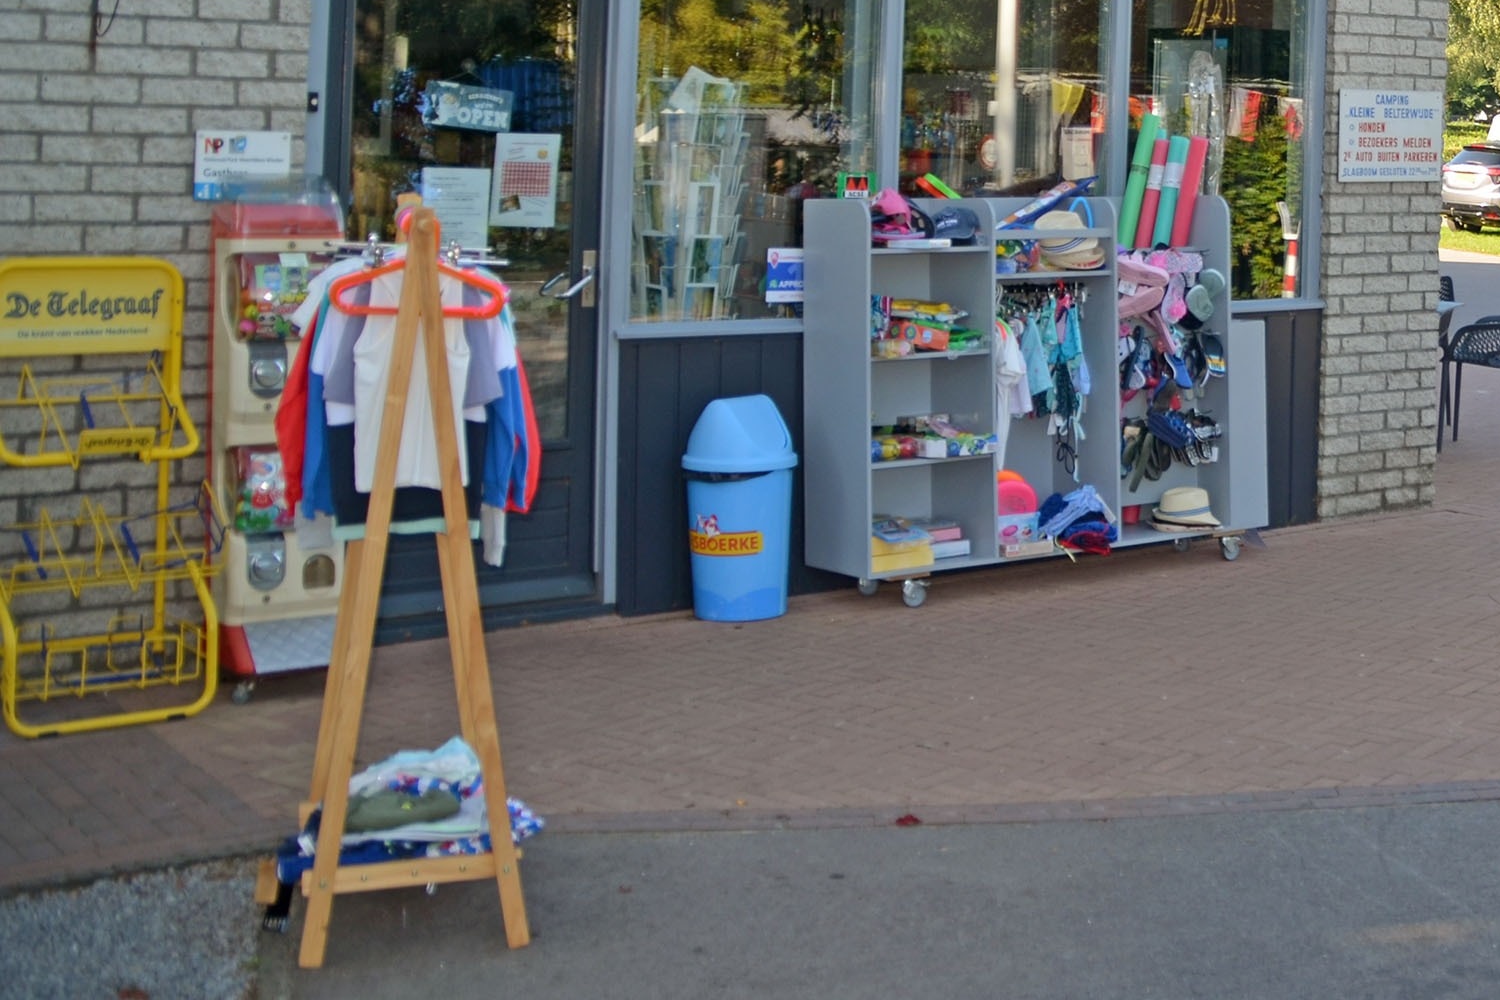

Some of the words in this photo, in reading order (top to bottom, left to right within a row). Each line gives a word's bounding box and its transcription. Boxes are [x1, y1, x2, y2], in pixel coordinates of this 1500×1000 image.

[1375, 94, 1409, 105] CAMPING
[457, 107, 509, 129] OPEN
[1358, 122, 1386, 133] HONDEN
[1358, 136, 1398, 148] BEZOEKERS
[1403, 137, 1432, 148] MELDEN
[1356, 151, 1373, 162] AUTO
[1377, 151, 1400, 162] BUITEN
[1403, 151, 1438, 162] PARKEREN
[1343, 167, 1377, 177] SLAGBOOM
[1379, 167, 1407, 177] GESLOTEN
[4, 291, 42, 319] De
[46, 288, 165, 321] Telegraaf
[17, 330, 29, 338] De
[31, 329, 54, 338] krant
[73, 328, 103, 337] wakker
[105, 327, 148, 336] Nederland
[691, 535, 759, 552] SBOERKE
